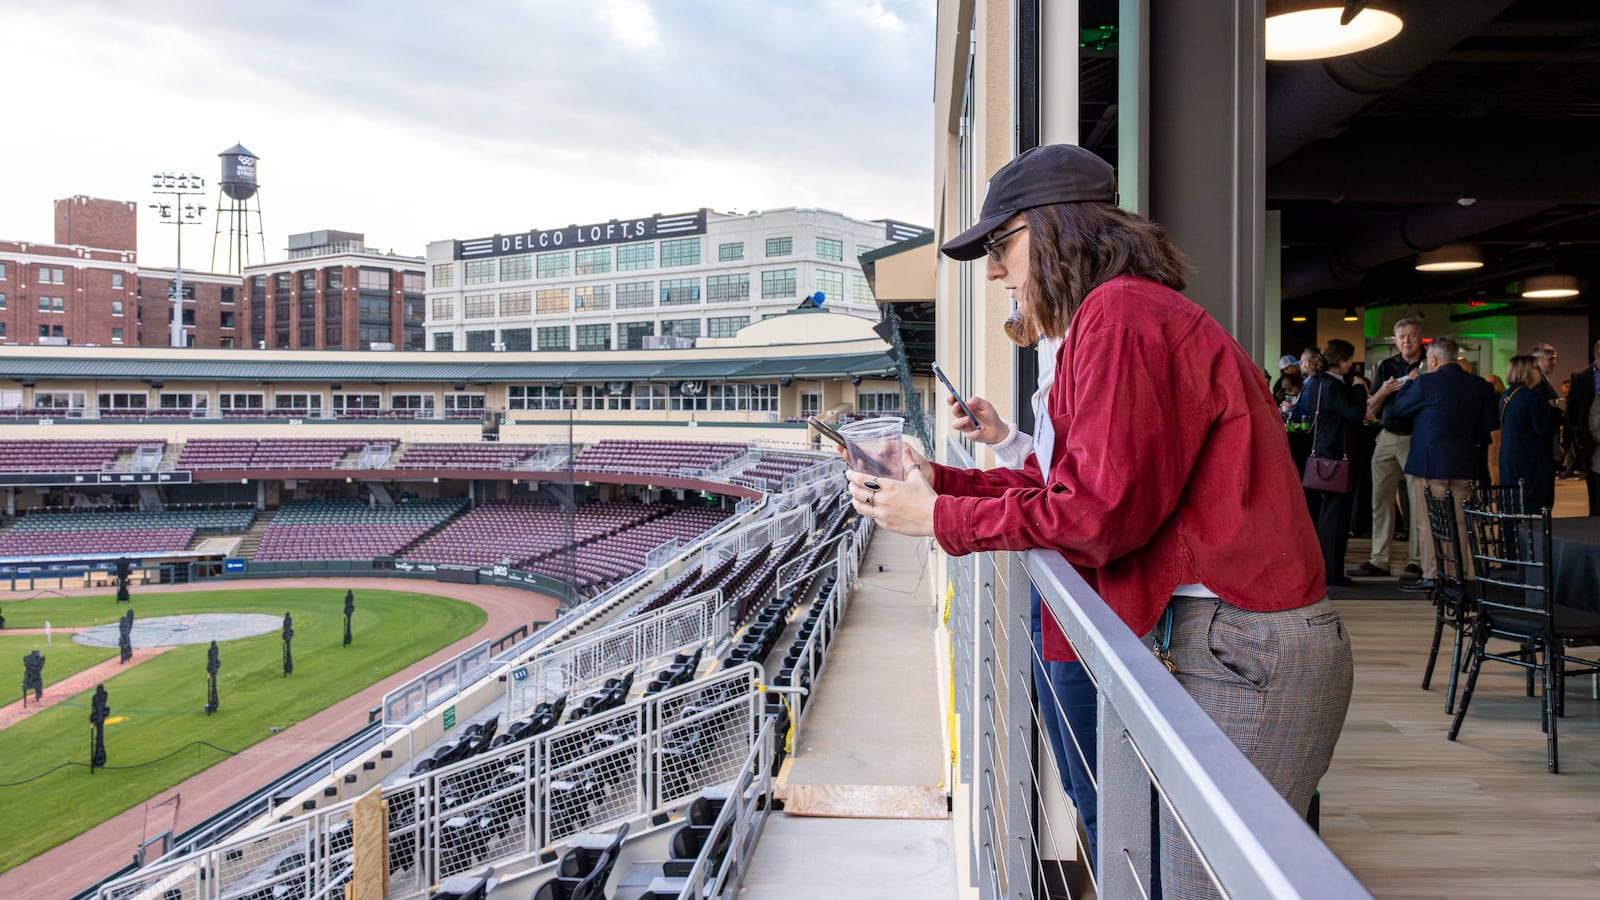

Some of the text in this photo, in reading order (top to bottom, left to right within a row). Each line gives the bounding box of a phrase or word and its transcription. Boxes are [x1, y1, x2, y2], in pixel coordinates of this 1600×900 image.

[502, 221, 645, 251] DELCO LOFTS
[493, 565, 508, 577] aes
